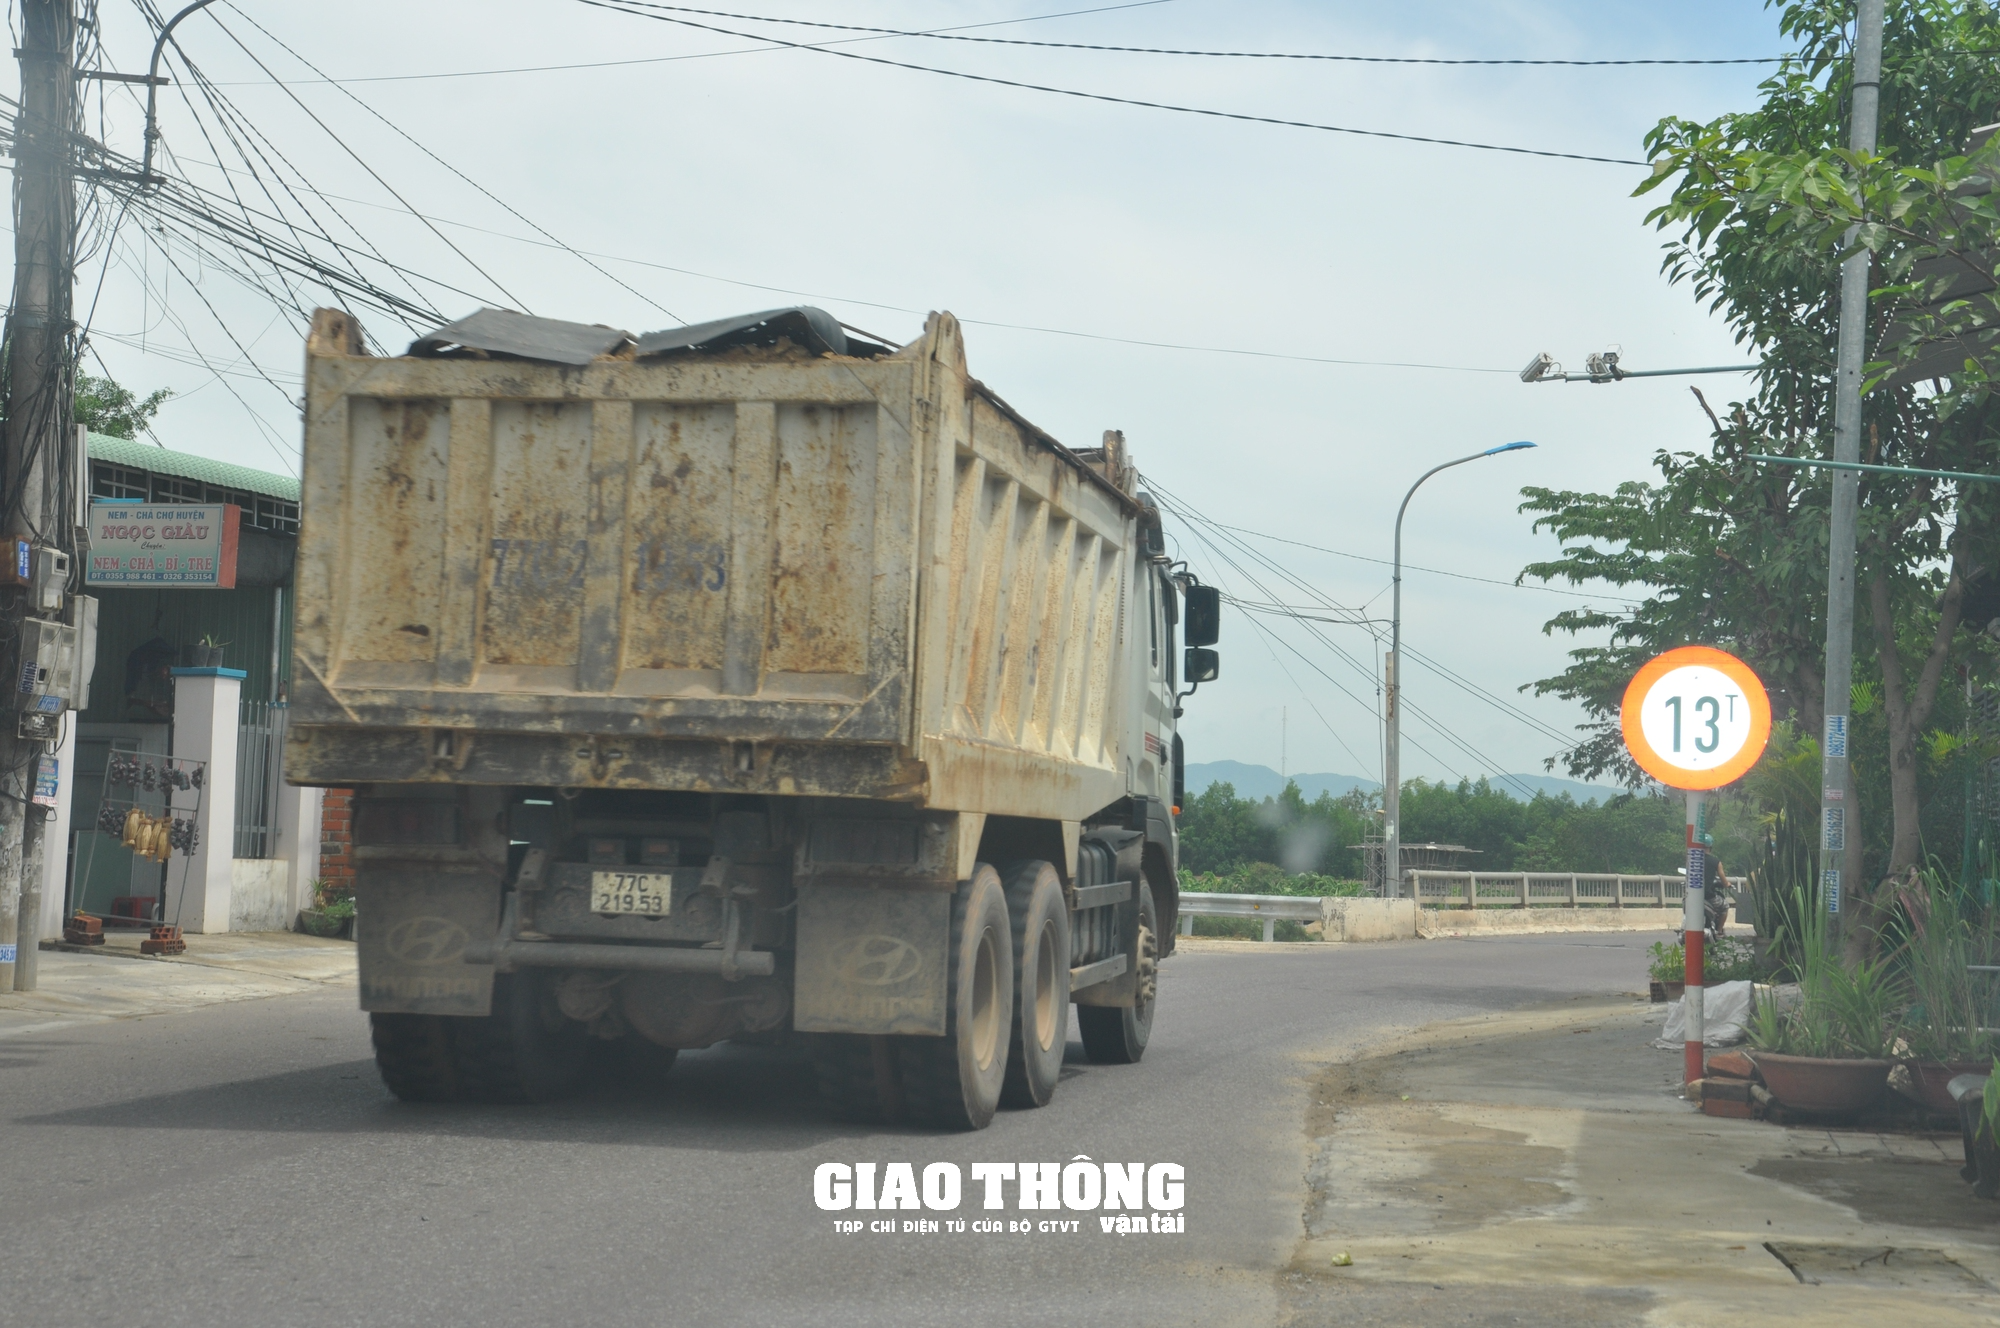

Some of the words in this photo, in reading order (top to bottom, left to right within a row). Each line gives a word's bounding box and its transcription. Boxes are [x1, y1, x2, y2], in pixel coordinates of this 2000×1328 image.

[107, 511, 128, 519] NEM
[136, 509, 153, 519] CHẢ
[156, 510, 174, 521] CHỢ
[176, 510, 205, 521] HUYỆN
[101, 525, 155, 542] NGỌC
[161, 522, 209, 539] GIÀU
[93, 557, 120, 570] NEM
[129, 552, 155, 570] CHẢ
[165, 554, 178, 571] BÌ
[1665, 696, 1720, 753] 13
[1724, 694, 1739, 722] T
[615, 874, 648, 892] 77C
[600, 893, 662, 913] 219.53
